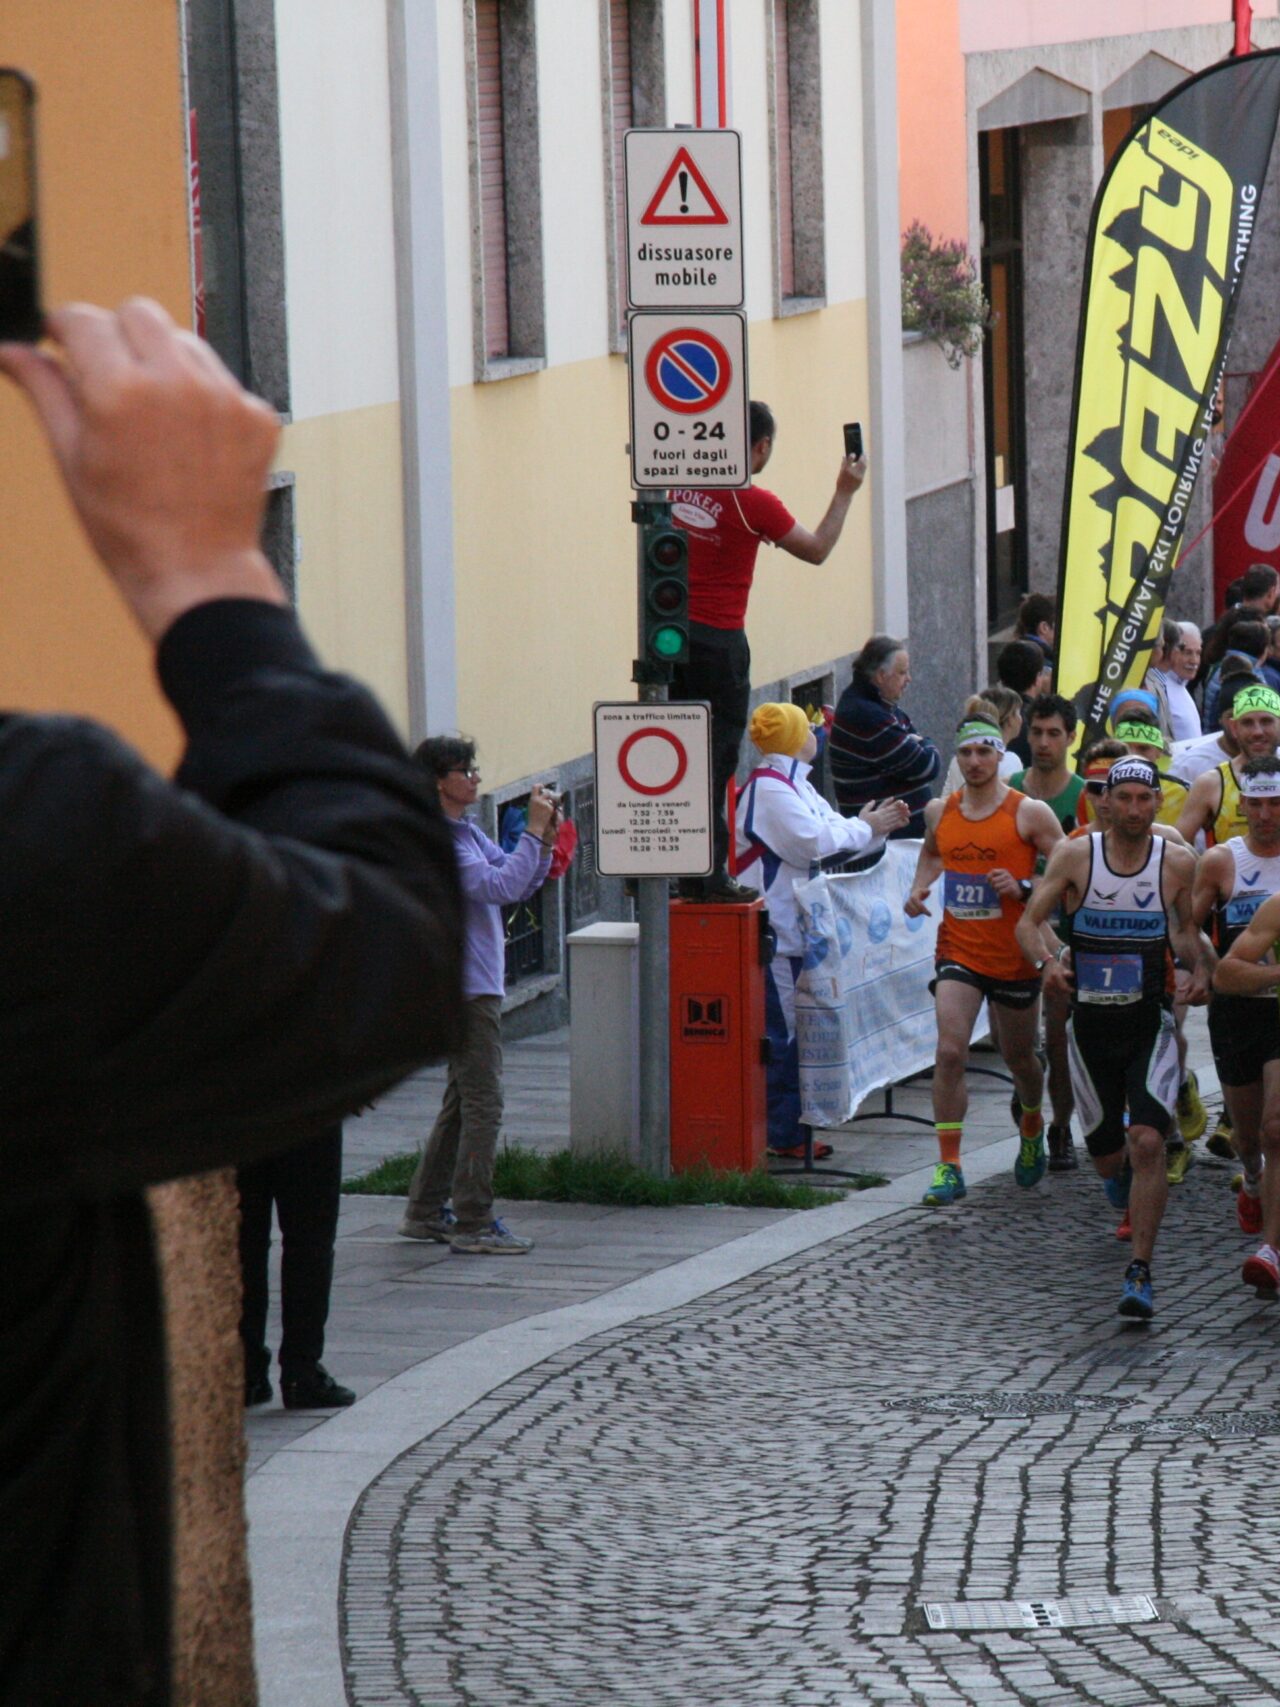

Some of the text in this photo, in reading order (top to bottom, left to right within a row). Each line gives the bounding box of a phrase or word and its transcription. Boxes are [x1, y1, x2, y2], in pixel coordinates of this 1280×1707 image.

[1157, 128, 1200, 160] idea
[1231, 184, 1257, 295] OTHING
[638, 243, 733, 260] dissuasore
[655, 267, 717, 286] mobile
[654, 422, 670, 440] 0
[693, 422, 725, 440] 24
[653, 449, 727, 461] fuori dagli
[644, 464, 737, 477] spazi segnati
[672, 489, 723, 518] POKER
[956, 884, 985, 904] 227
[1084, 914, 1161, 931] VALETUDO
[1102, 968, 1113, 988] 7
